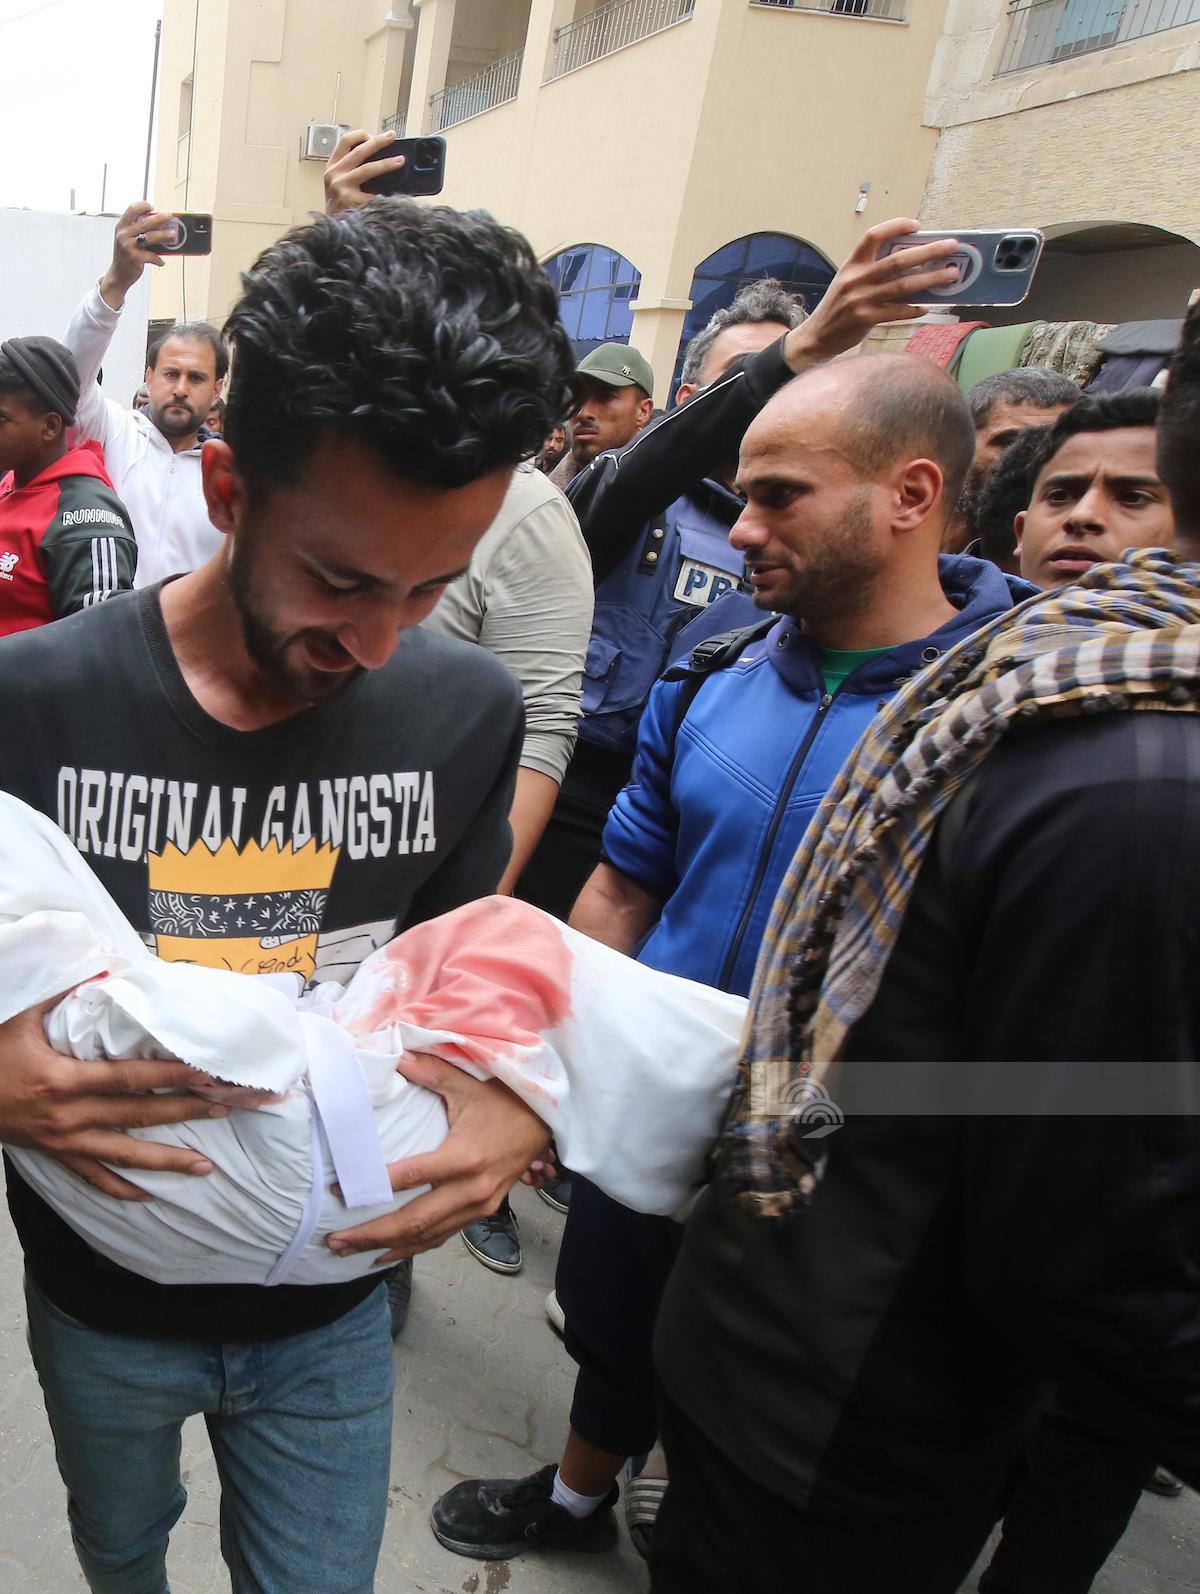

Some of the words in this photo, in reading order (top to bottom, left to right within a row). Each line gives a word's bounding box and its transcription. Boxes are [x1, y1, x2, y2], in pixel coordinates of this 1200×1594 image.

[62, 508, 125, 529] RUNNING
[683, 568, 733, 603] PR
[57, 766, 248, 864] ORIGINAL
[260, 770, 437, 860] GANGSTA
